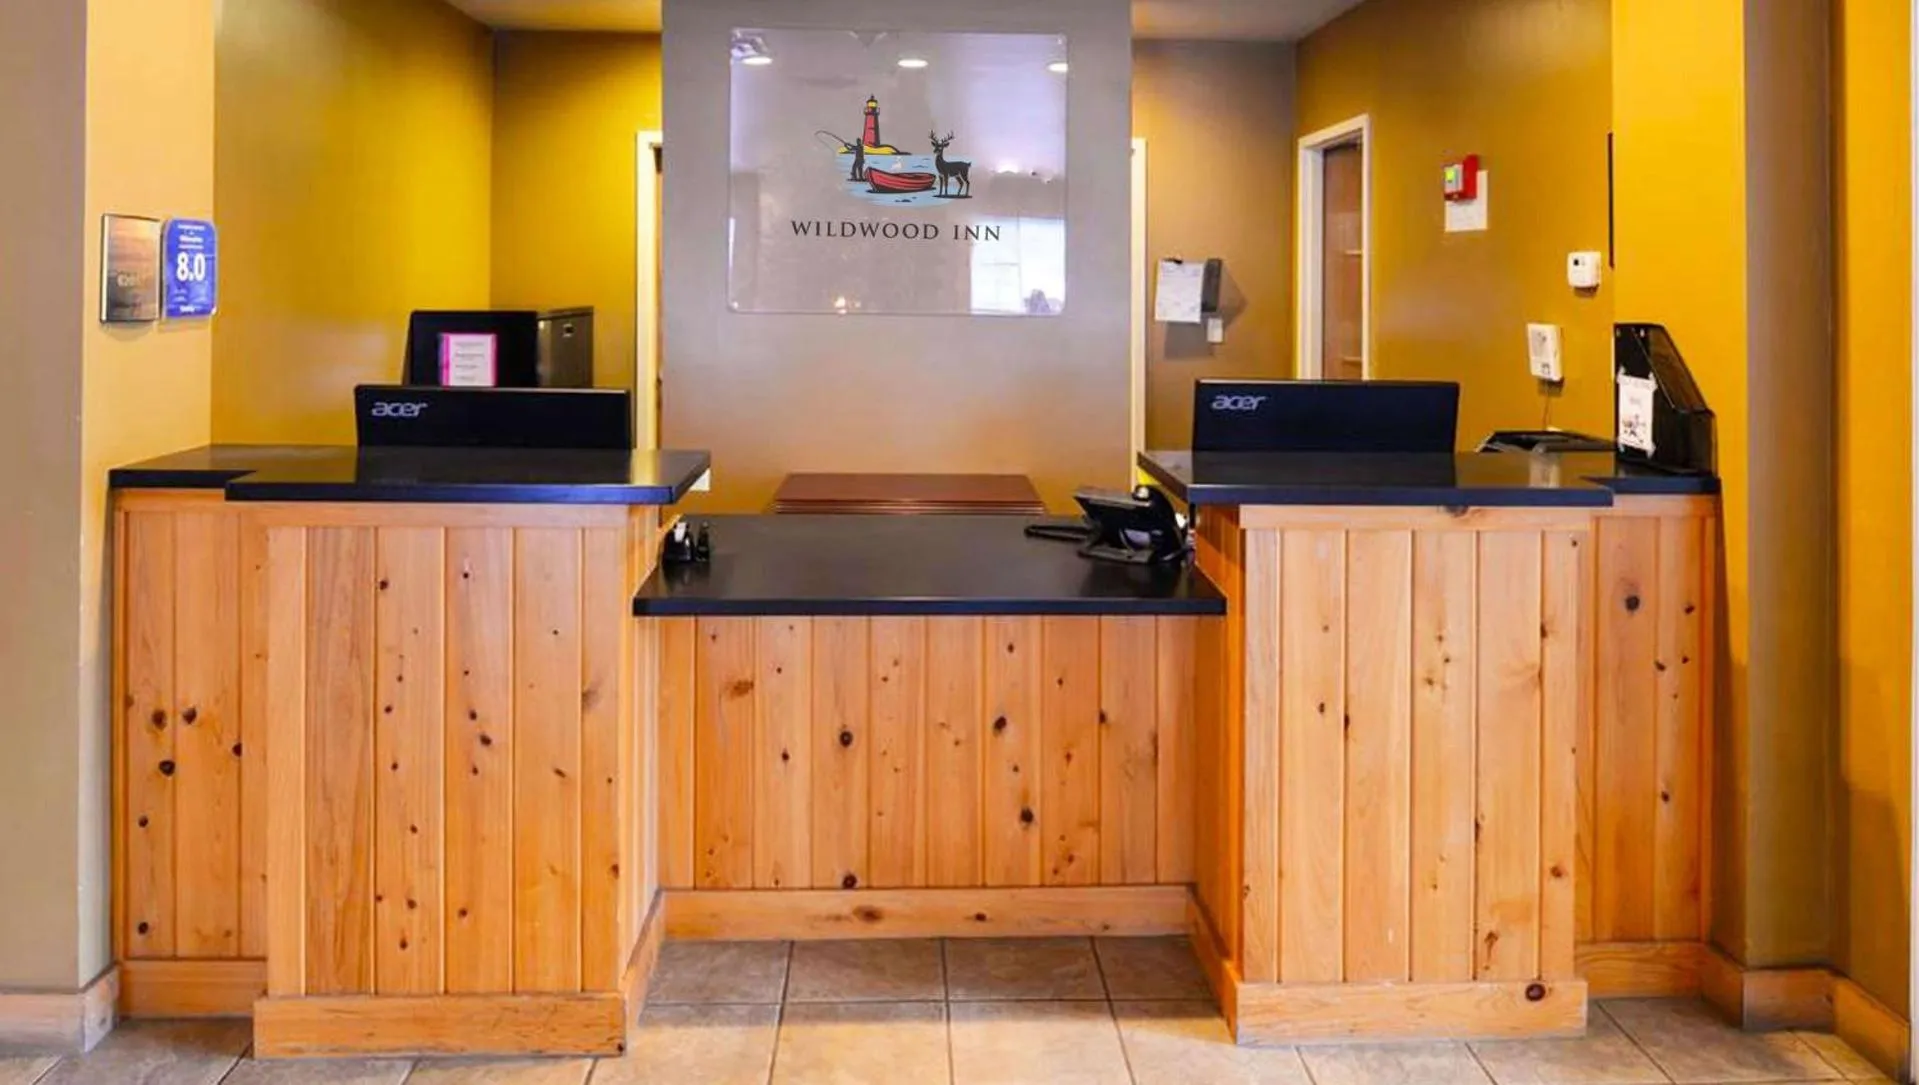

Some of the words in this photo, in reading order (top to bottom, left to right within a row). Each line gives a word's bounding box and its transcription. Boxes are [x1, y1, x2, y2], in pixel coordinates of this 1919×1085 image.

[791, 220, 939, 240] WILDWOOD
[953, 224, 1001, 241] INN
[177, 252, 206, 281] 8.0
[371, 401, 428, 417] acer
[1211, 395, 1266, 410] acer
